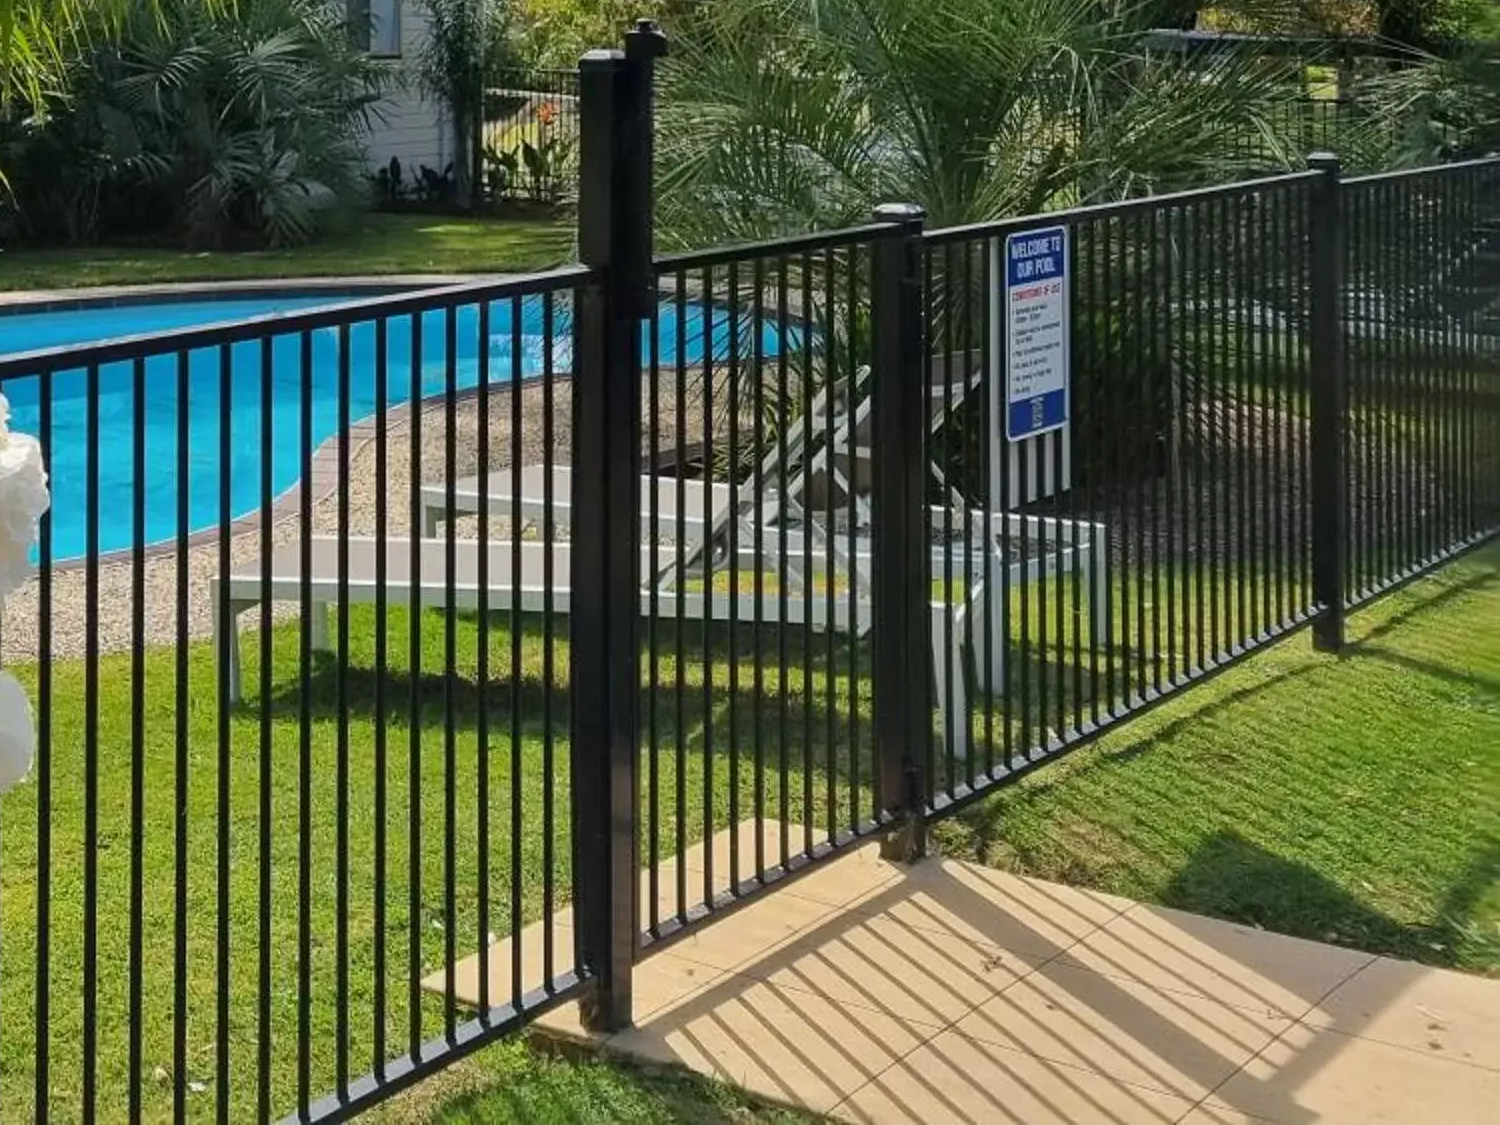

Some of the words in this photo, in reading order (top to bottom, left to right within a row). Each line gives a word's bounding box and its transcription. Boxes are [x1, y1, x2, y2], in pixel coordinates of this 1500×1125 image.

[1012, 238, 1050, 260] WELCOME
[1017, 260, 1034, 279] OUR
[1035, 256, 1056, 275] POOL
